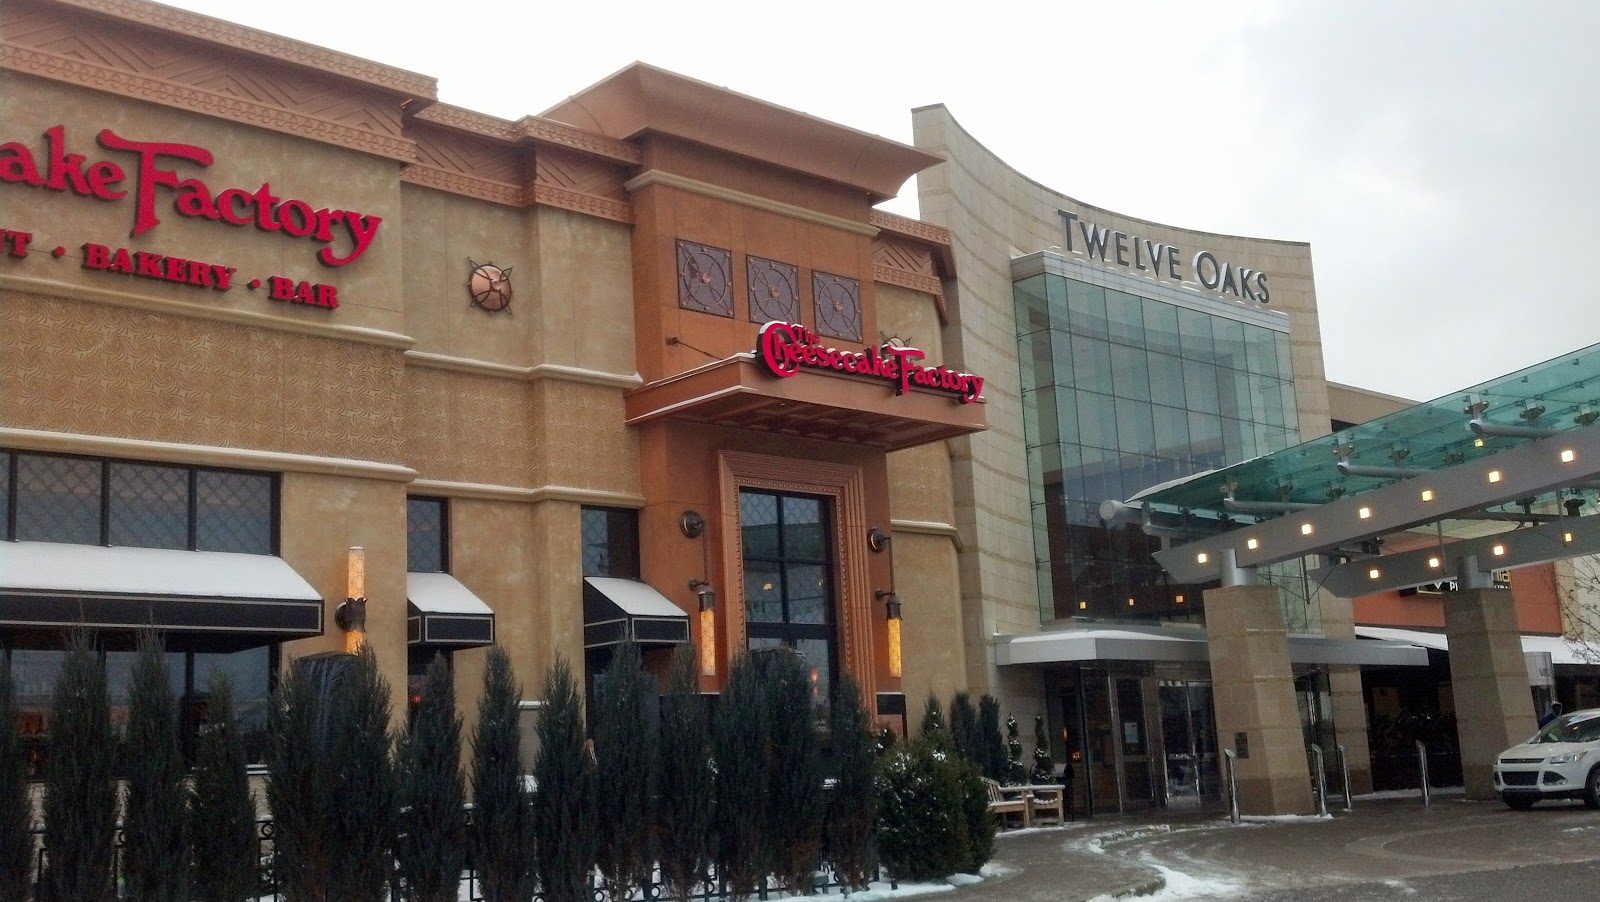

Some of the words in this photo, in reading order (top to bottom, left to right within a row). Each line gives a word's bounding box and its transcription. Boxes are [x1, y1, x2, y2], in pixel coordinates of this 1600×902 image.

[96, 128, 382, 268] Factory
[81, 242, 237, 291] BAKERY
[268, 275, 340, 310] BAR
[1057, 208, 1182, 281] TWELVE
[1193, 250, 1270, 304] OAKS
[757, 321, 899, 379] Cheesecake
[883, 344, 985, 404] Factory
[791, 324, 820, 344] The
